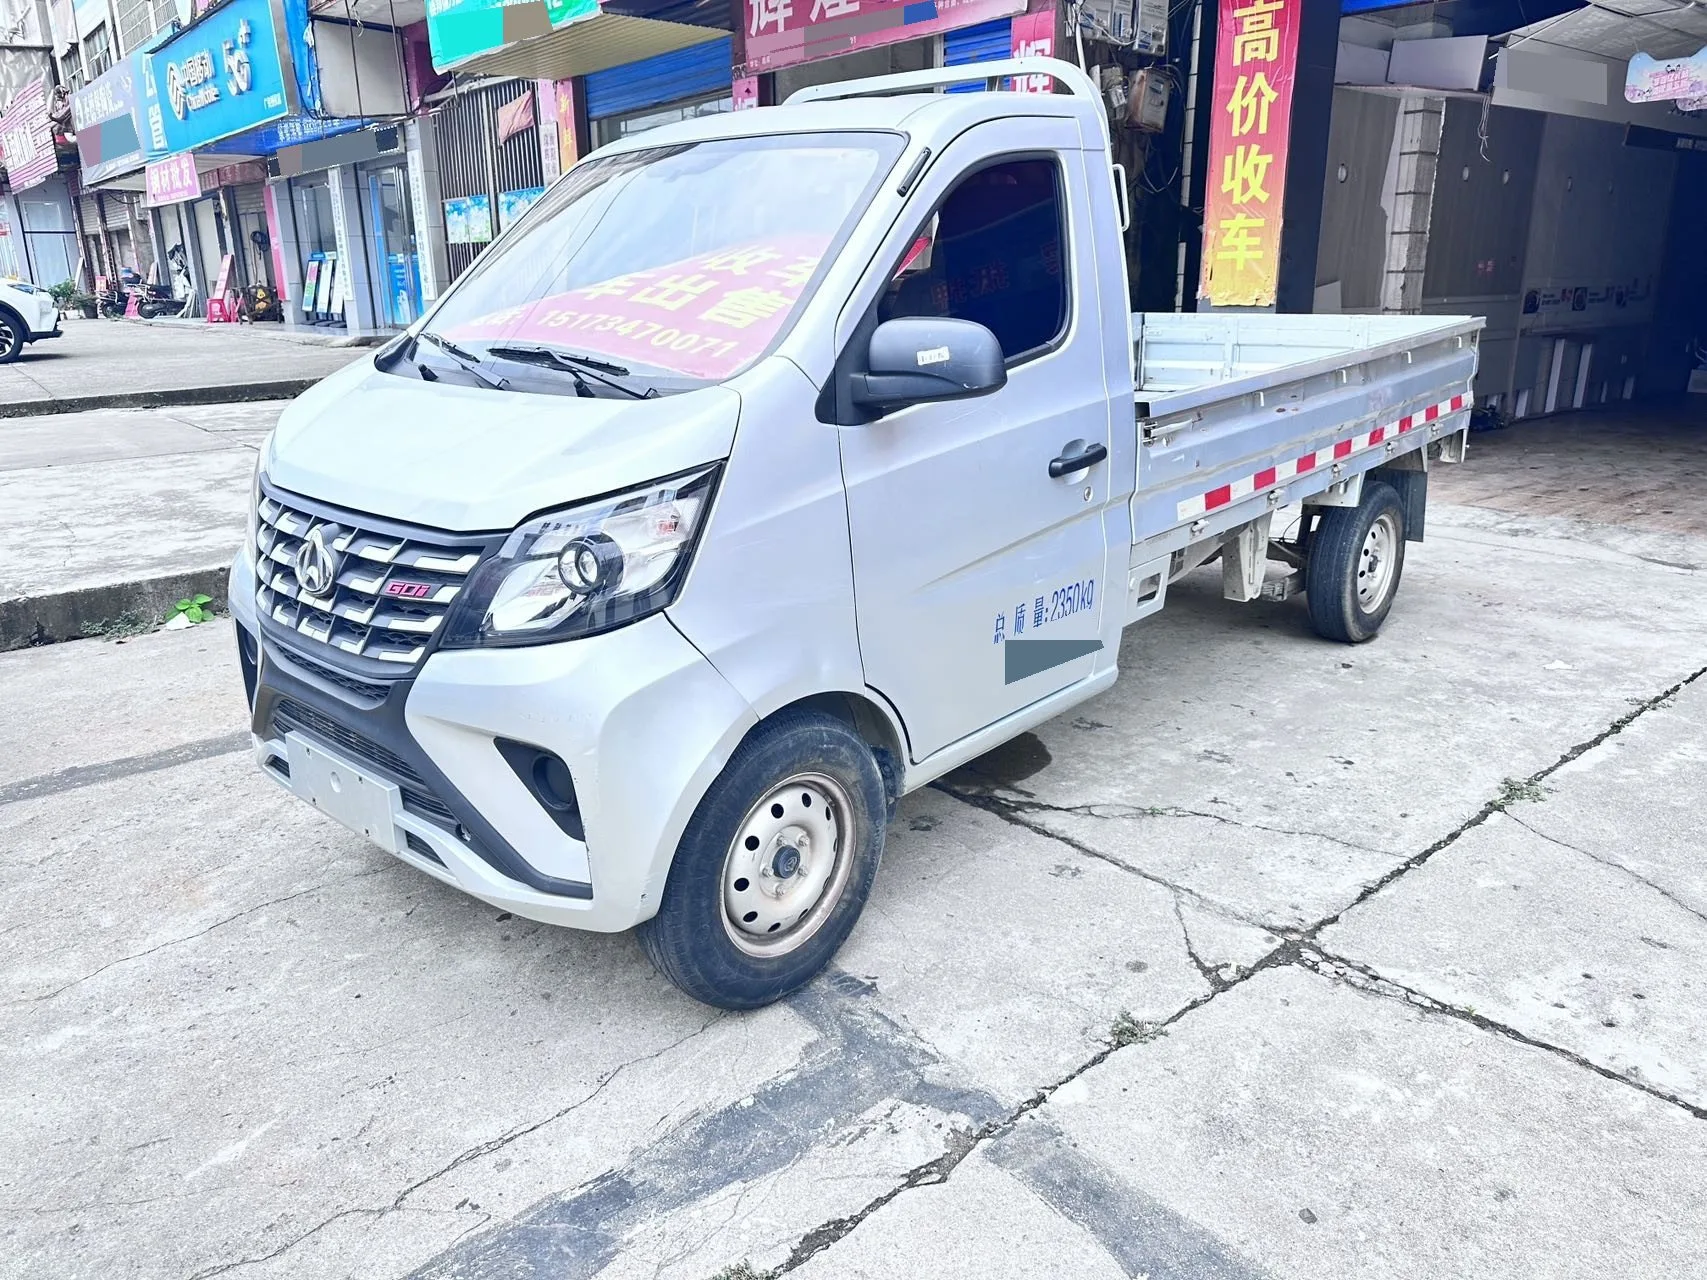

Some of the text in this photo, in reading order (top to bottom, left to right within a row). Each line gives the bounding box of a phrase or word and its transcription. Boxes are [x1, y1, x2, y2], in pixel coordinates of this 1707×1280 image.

[1216, 0, 1284, 271] 高价收车
[537, 309, 740, 358] 15173470071
